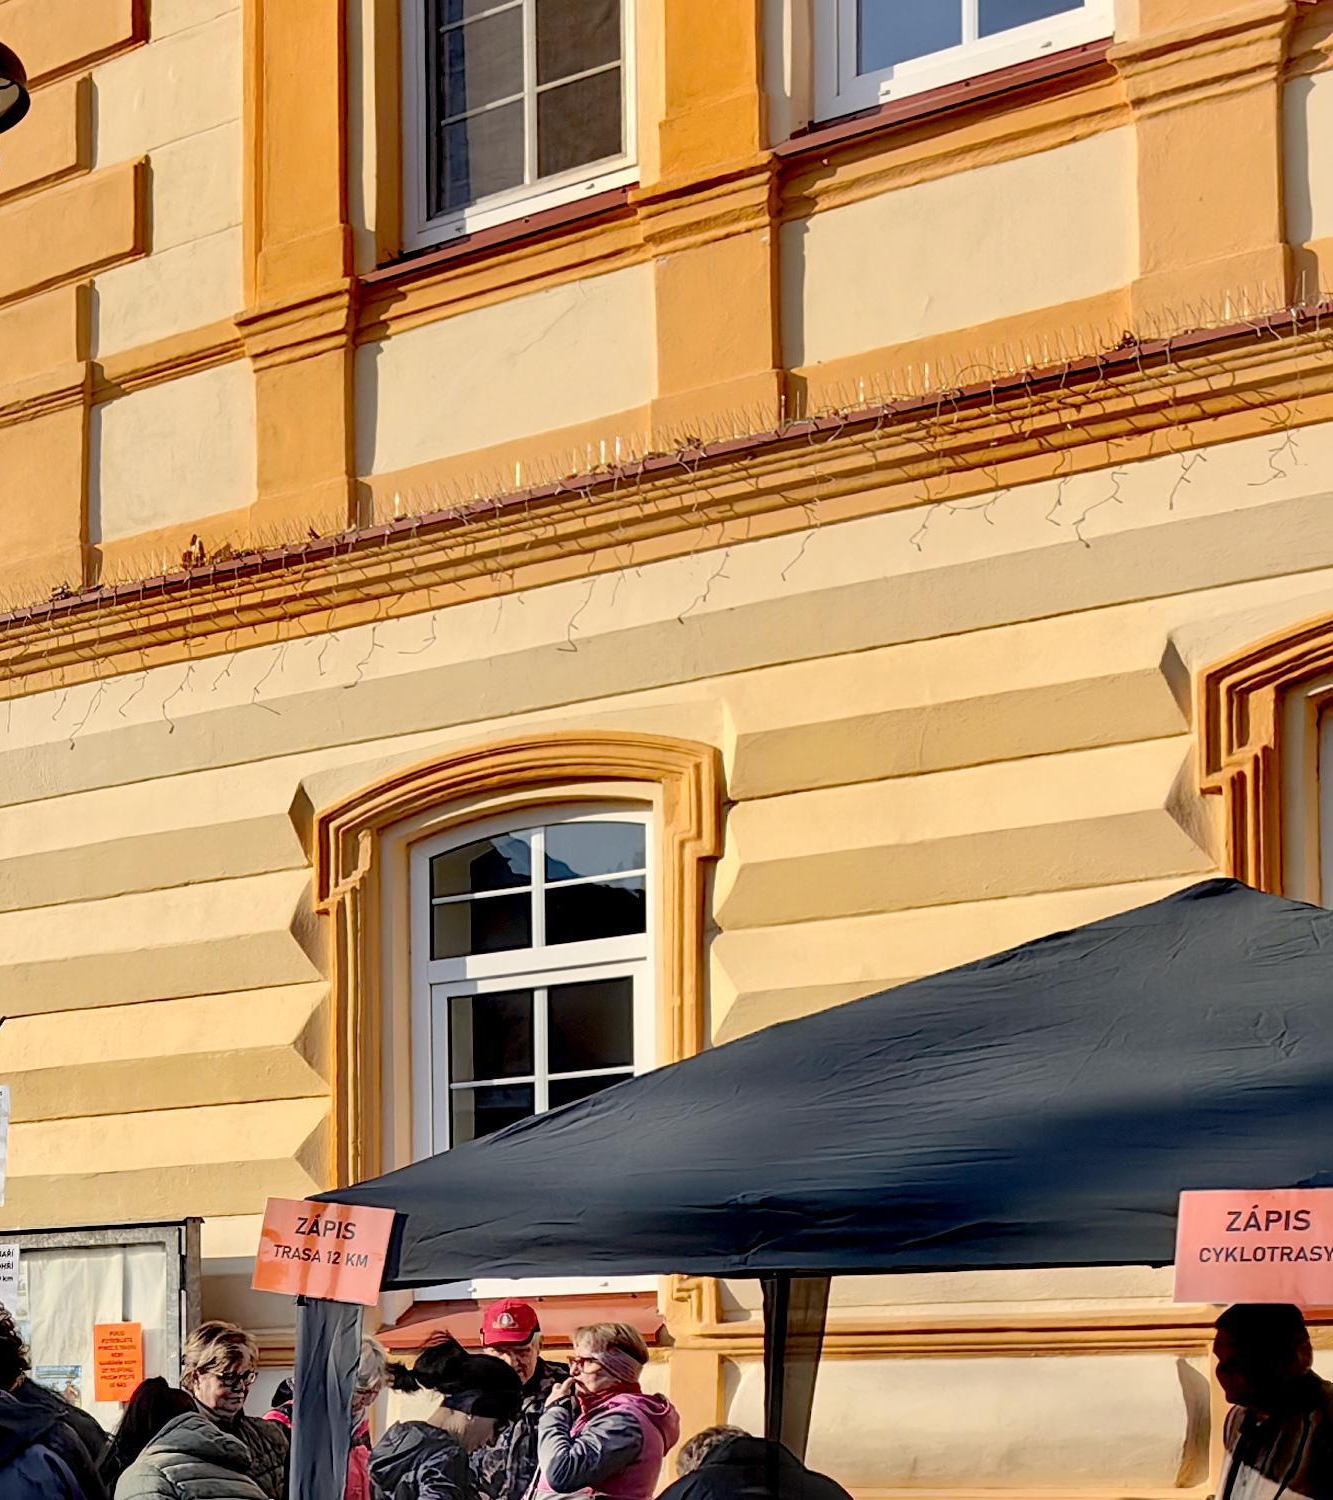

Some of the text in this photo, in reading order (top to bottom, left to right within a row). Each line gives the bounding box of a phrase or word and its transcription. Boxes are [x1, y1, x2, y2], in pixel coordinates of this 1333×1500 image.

[295, 1213, 357, 1241] ZÁPIS
[1225, 1204, 1311, 1232] ZÁPIS
[273, 1244, 369, 1268] TRASA 12 KM
[1199, 1246, 1333, 1263] CYKLOTRASY
[2, 1275, 14, 1283] km
